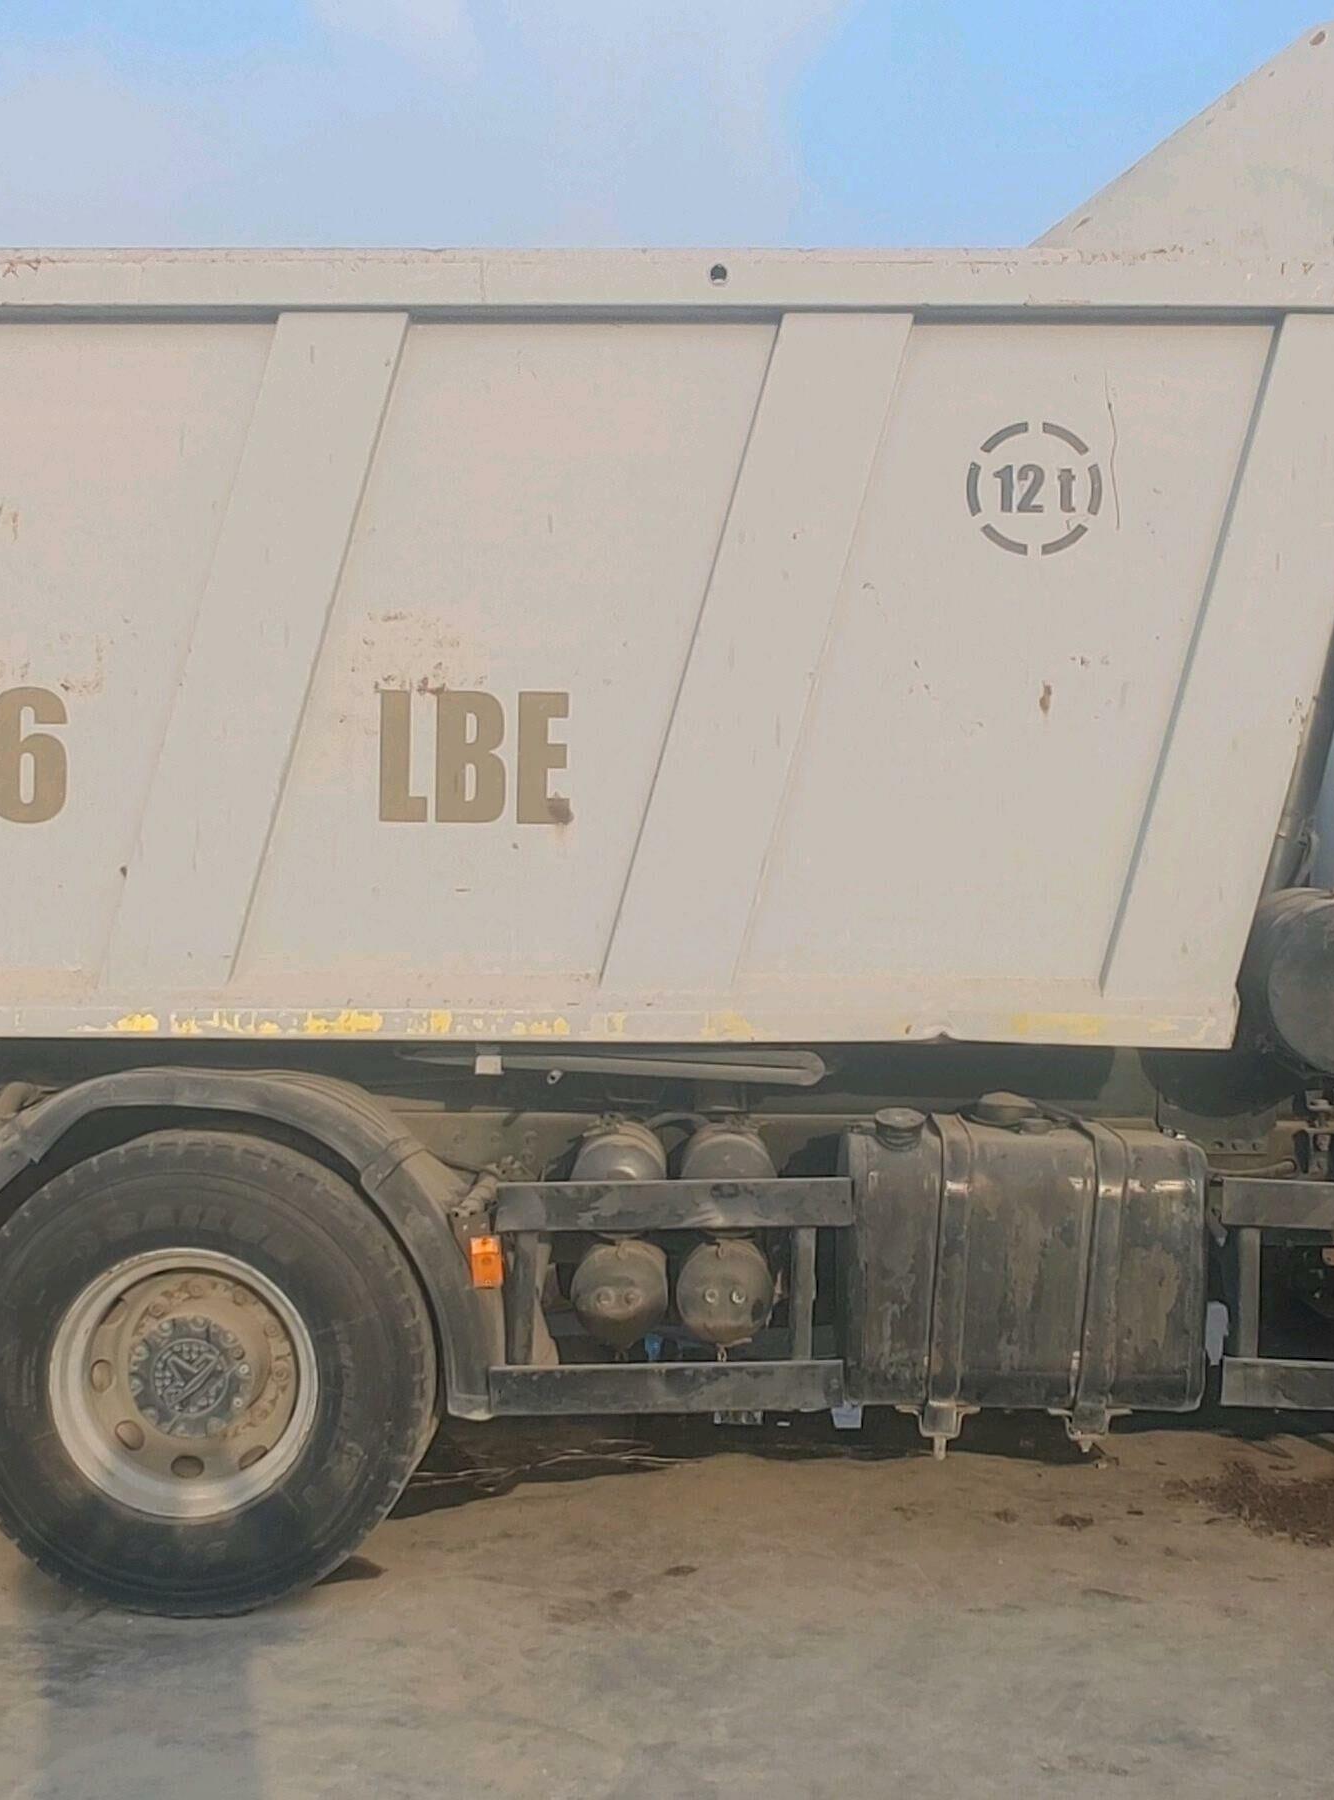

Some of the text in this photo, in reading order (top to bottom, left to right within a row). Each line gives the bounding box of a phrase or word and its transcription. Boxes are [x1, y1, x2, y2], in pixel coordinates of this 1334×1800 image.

[993, 464, 1076, 513] 12 t
[378, 690, 570, 825] LBE
